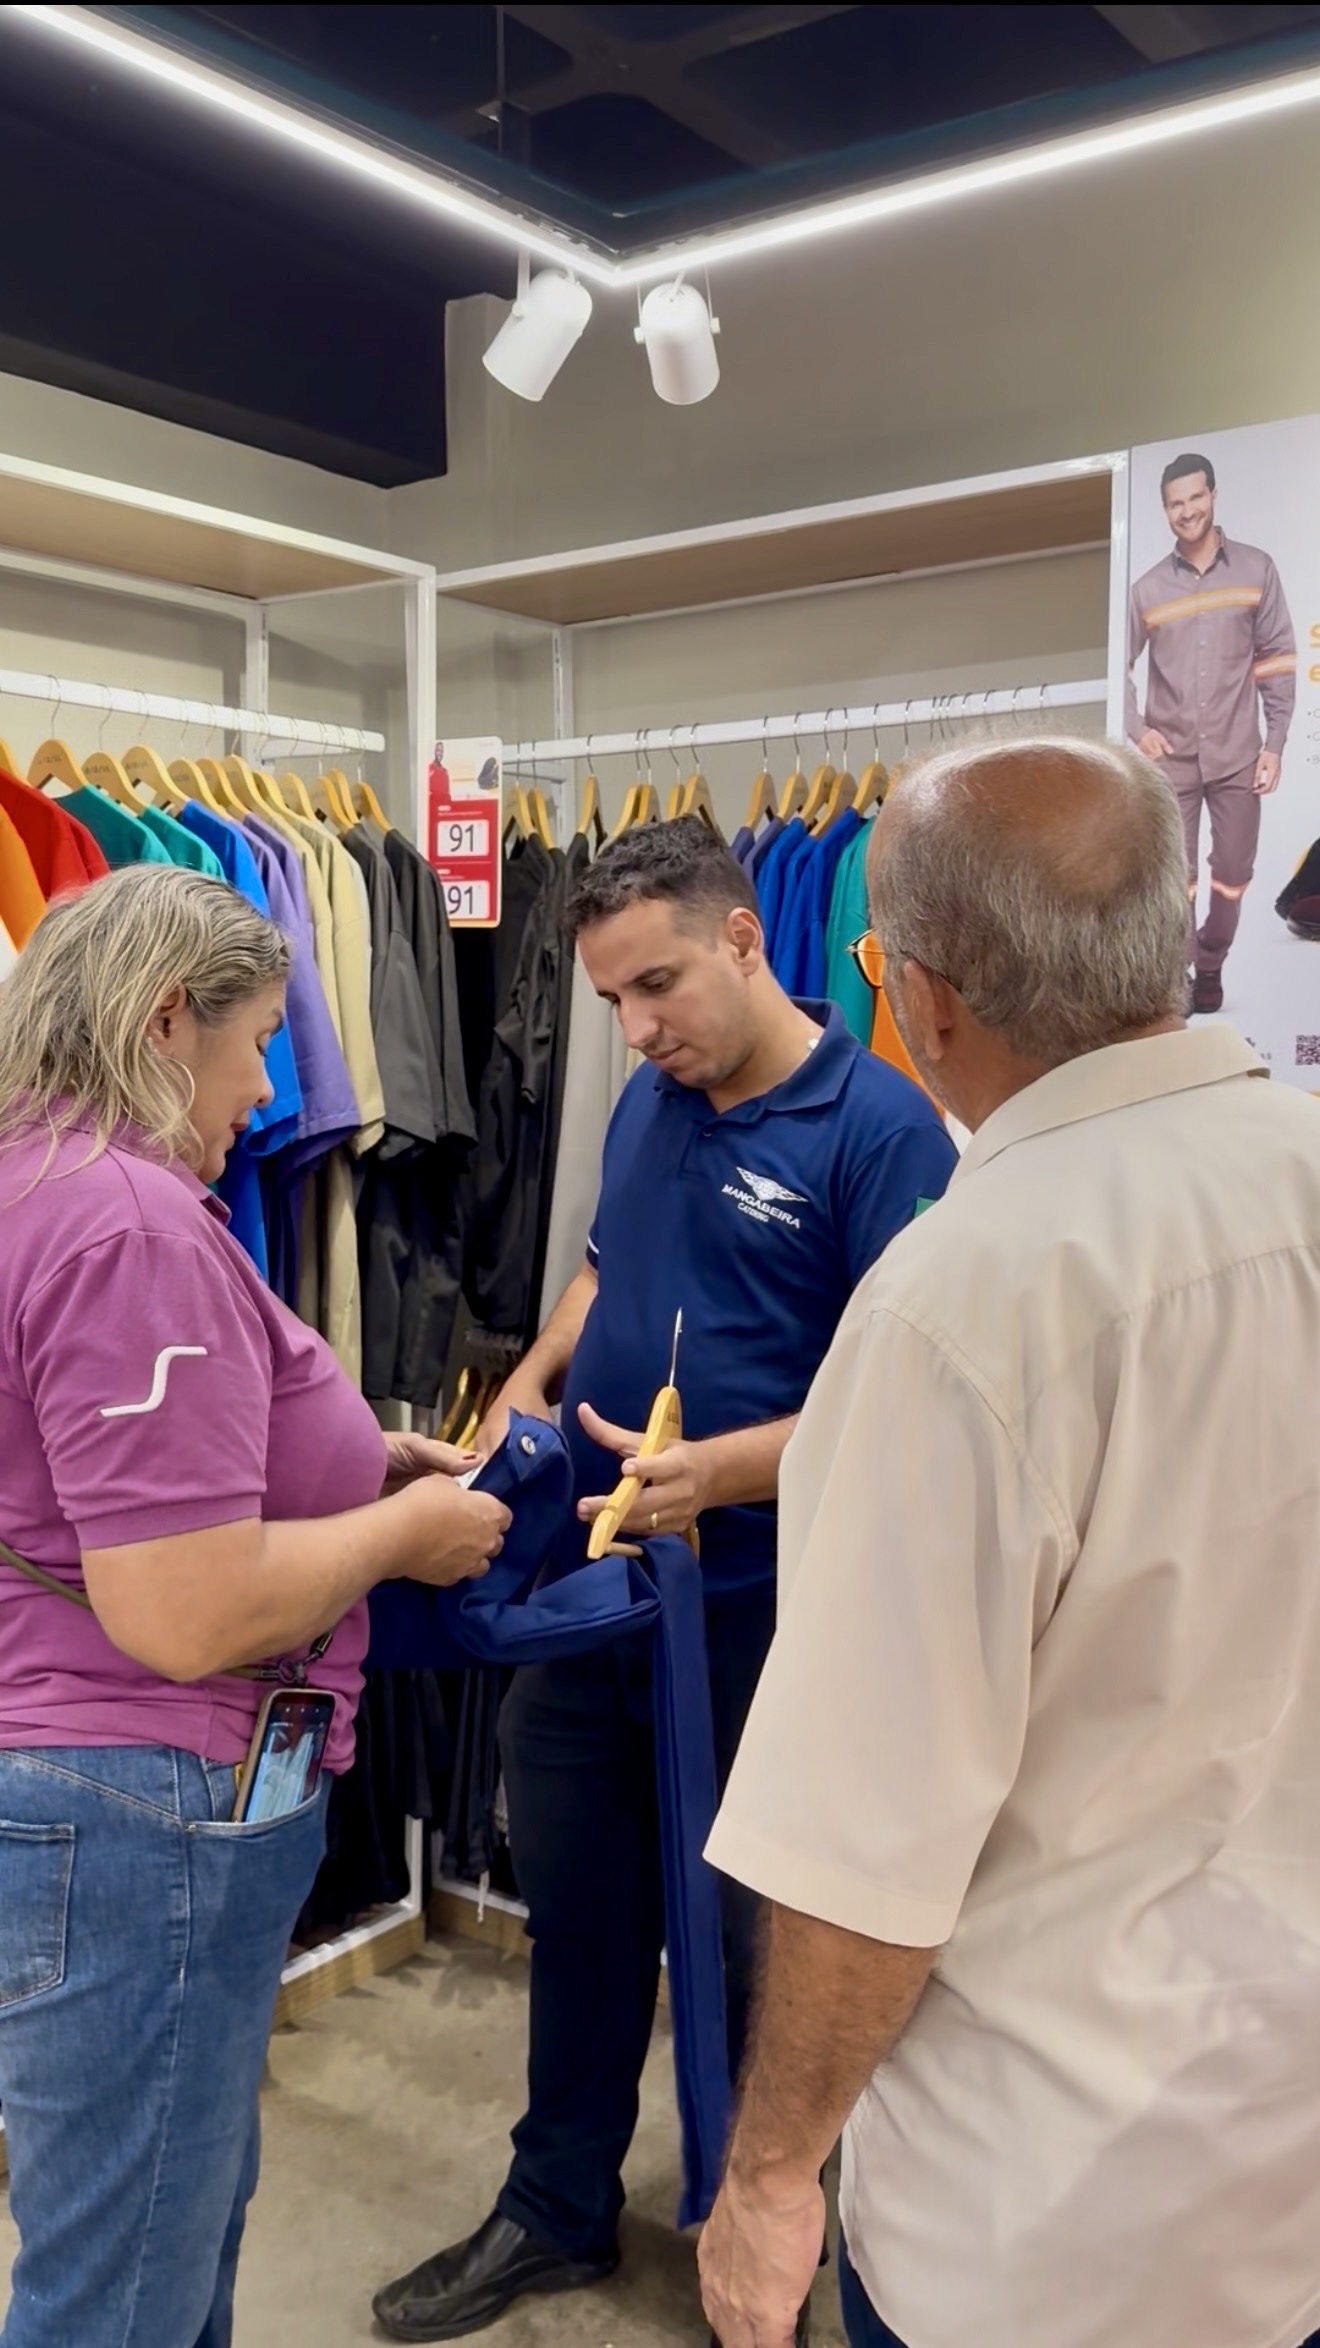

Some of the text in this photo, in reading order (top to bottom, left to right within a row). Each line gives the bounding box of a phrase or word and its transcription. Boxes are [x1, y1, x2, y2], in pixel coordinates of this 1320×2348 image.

[449, 823, 474, 852] 91
[447, 884, 474, 915] 91
[721, 1184, 800, 1229] MANGABEIRA
